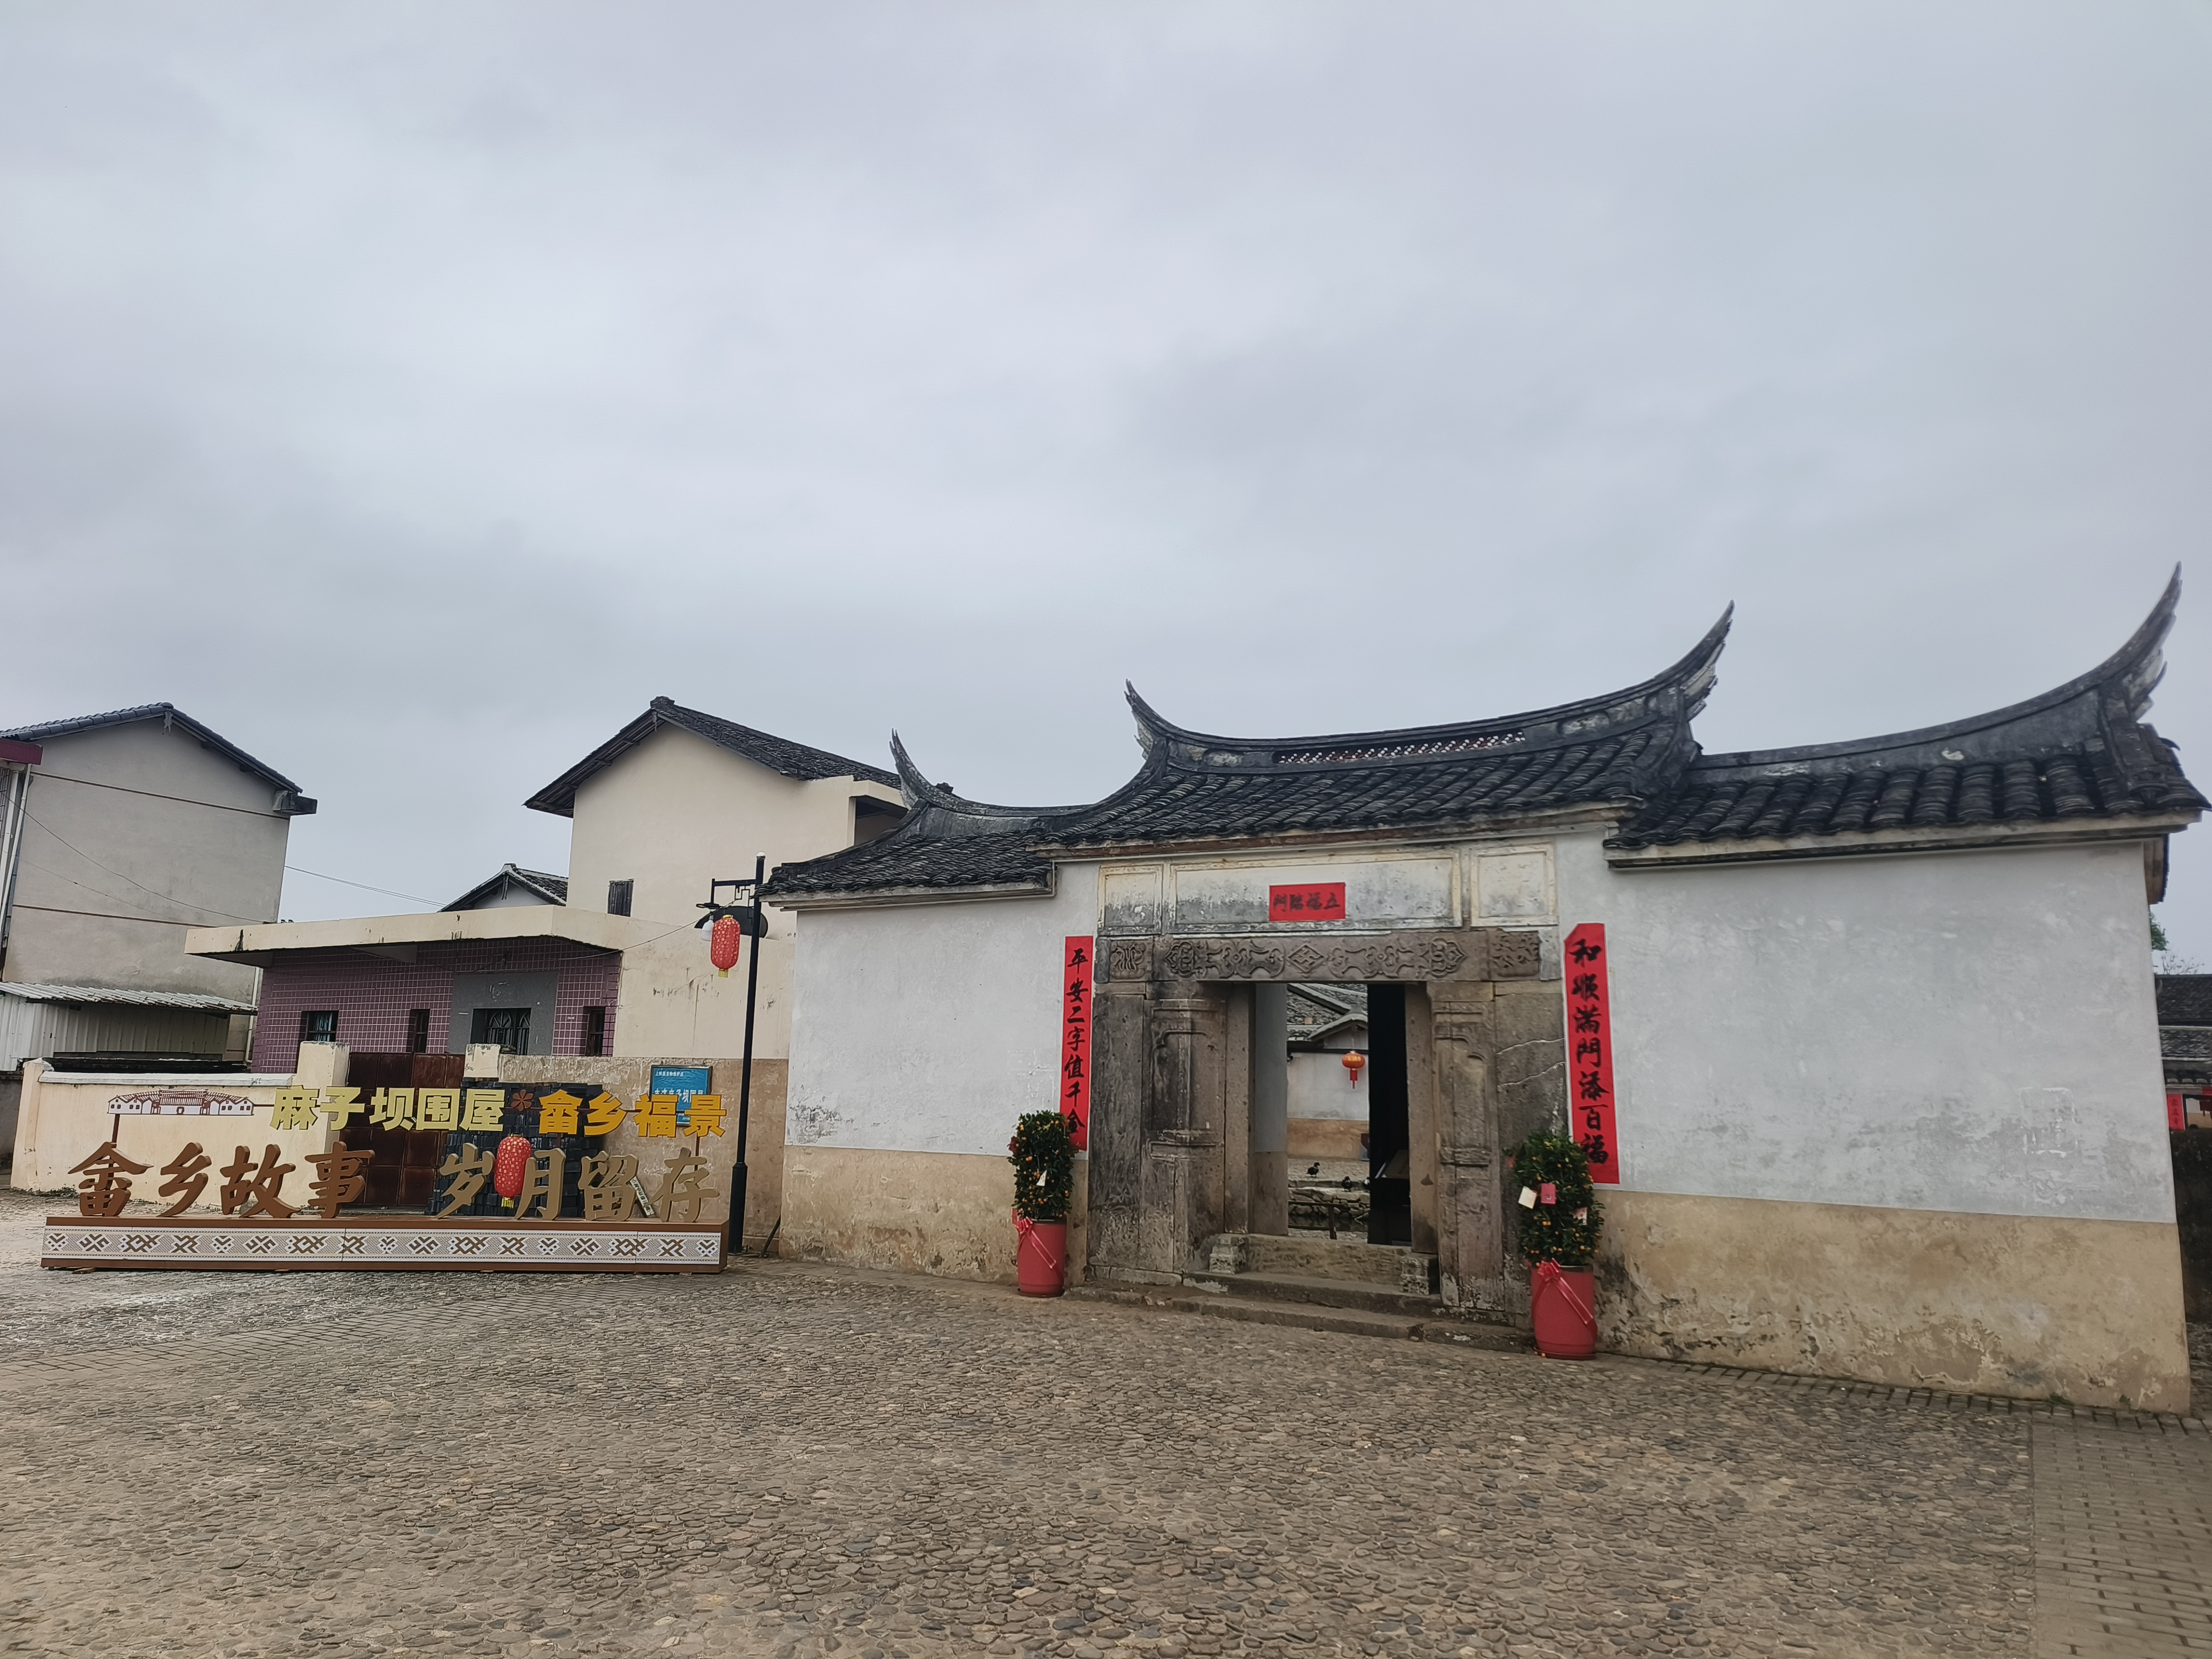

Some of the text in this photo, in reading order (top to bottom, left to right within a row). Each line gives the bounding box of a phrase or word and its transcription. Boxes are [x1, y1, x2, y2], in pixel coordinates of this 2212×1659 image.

[1064, 947, 1089, 1134] 平安二字值千金
[270, 1085, 505, 1131] 麻子坝围屋
[437, 1142, 720, 1222] 岁月留存
